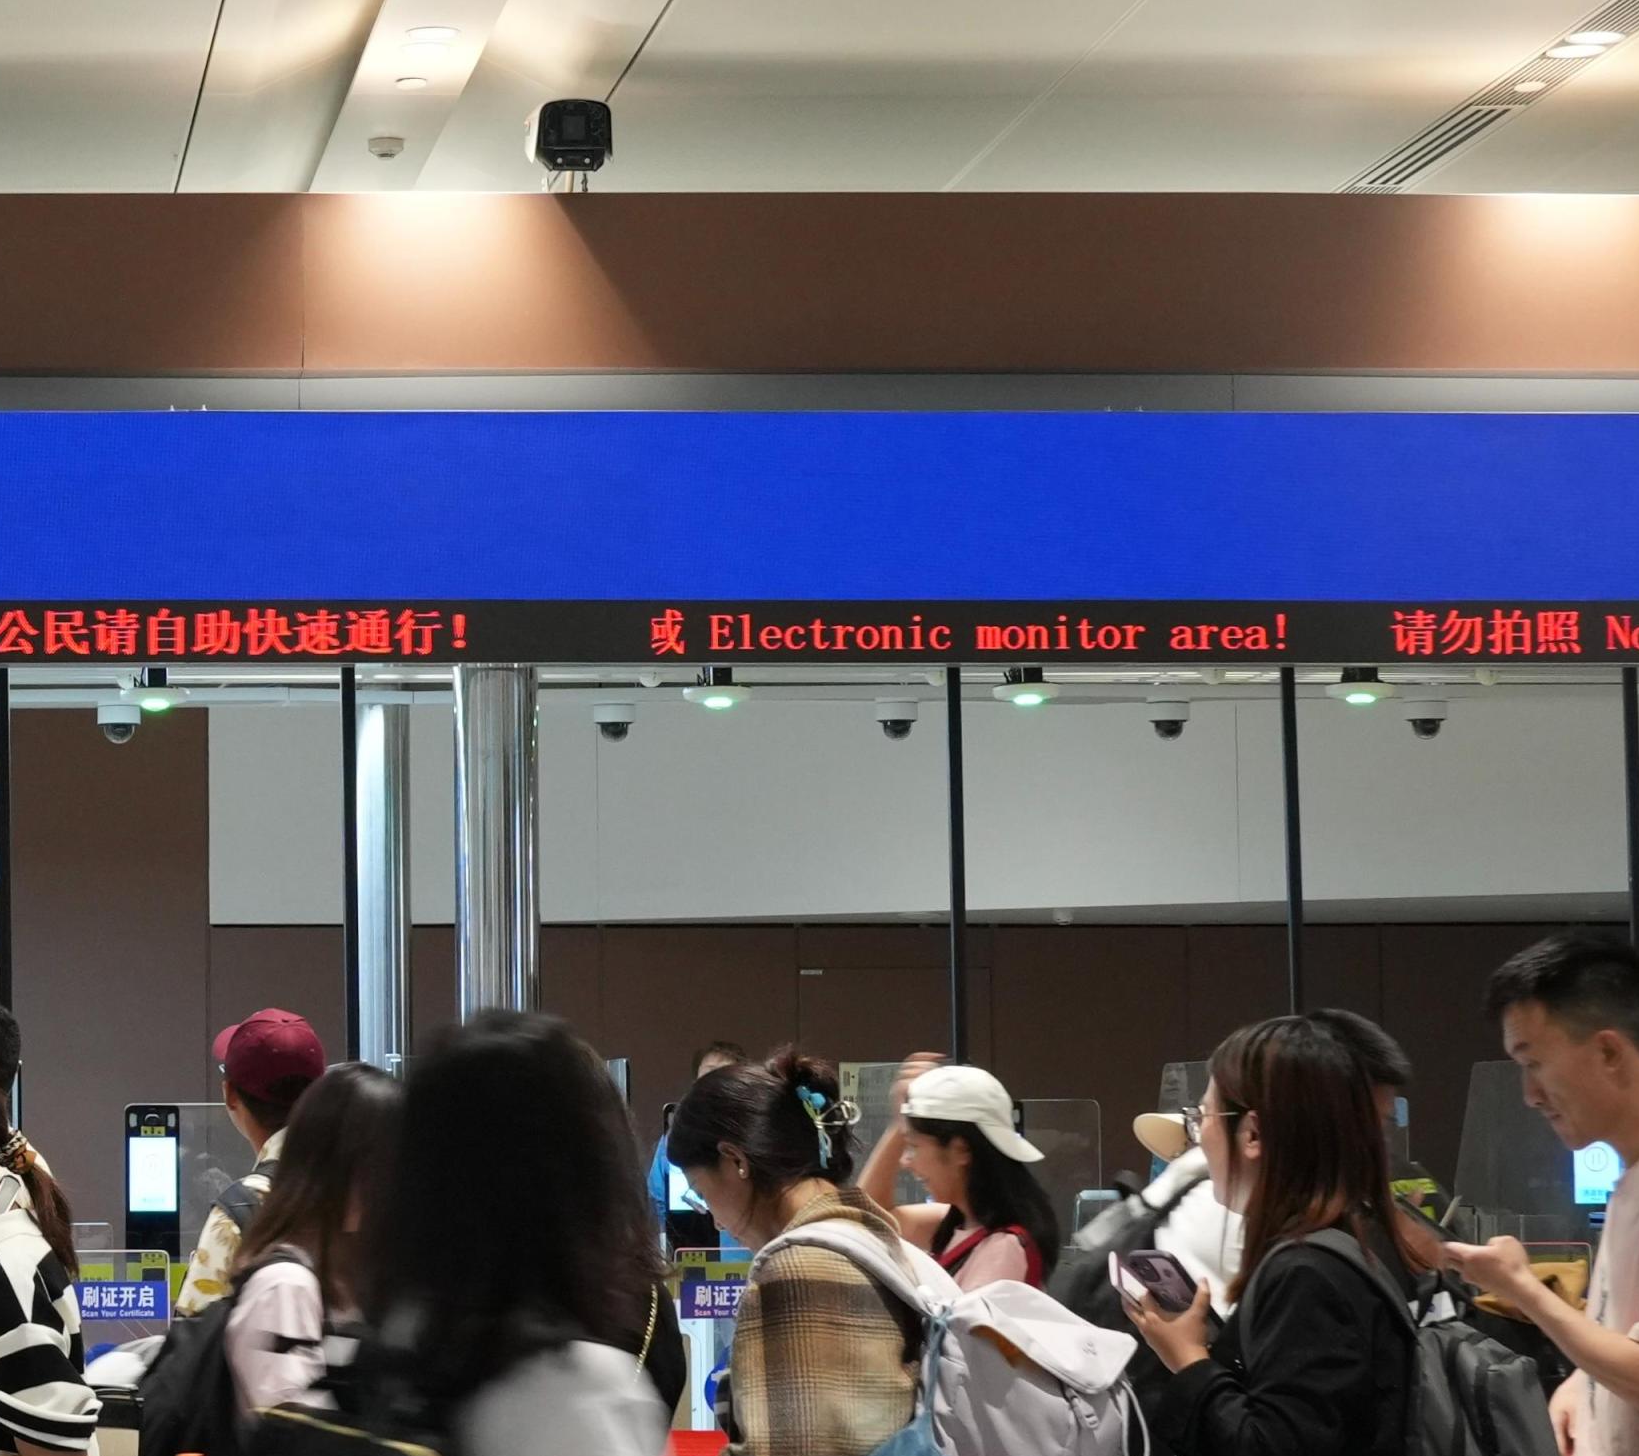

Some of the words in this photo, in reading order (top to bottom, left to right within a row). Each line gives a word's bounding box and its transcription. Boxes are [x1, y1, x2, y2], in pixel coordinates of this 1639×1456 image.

[708, 613, 952, 650] Electronic
[975, 614, 1147, 650] monitor
[1169, 613, 1289, 650] area!
[1390, 609, 1582, 655] 请勿拍照
[81, 1285, 155, 1308] 刷证开启
[694, 1285, 747, 1307] 刷证开
[81, 1309, 99, 1318] Scan
[101, 1309, 117, 1318] Your
[119, 1309, 155, 1318] Certificate
[694, 1309, 712, 1317] Scan
[713, 1309, 729, 1317] Your
